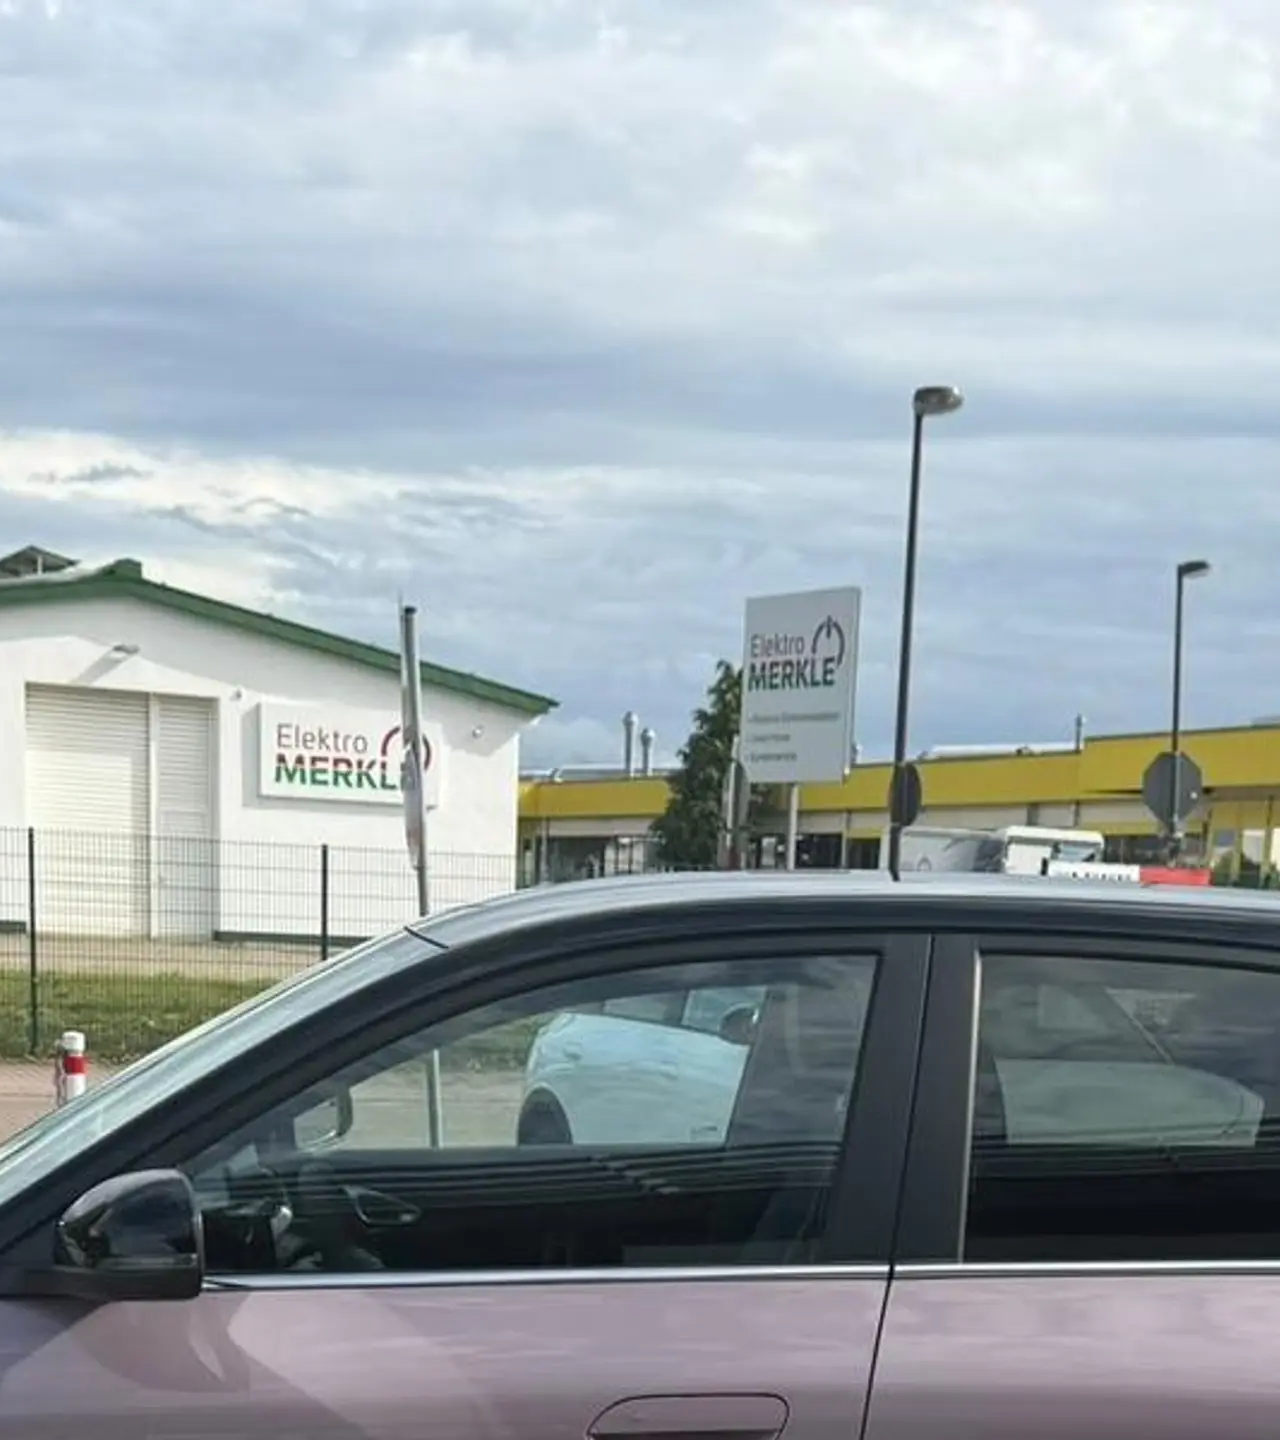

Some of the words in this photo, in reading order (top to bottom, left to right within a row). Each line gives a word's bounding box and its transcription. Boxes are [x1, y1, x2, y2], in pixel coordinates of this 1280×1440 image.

[750, 633, 805, 658] Elektro
[748, 656, 836, 692] MERKLE
[276, 722, 368, 754] Elektro
[274, 752, 408, 791] MERKL
